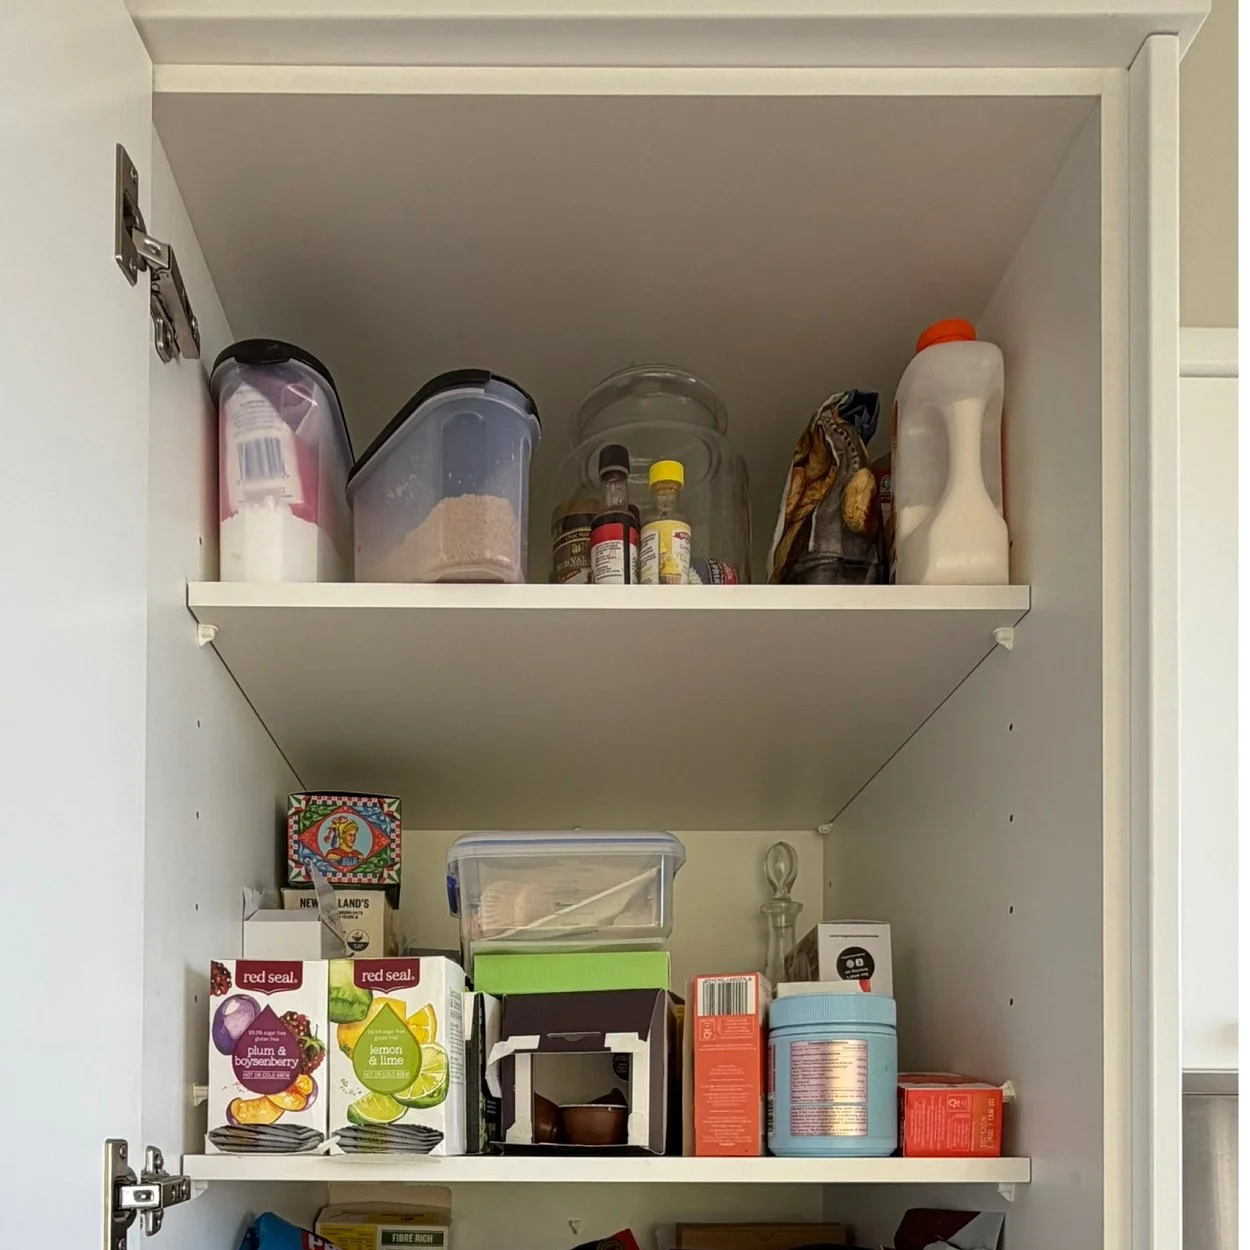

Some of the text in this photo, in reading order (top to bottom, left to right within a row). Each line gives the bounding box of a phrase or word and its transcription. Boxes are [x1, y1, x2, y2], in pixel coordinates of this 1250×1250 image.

[243, 971, 294, 983] red seal
[362, 969, 411, 982] red seal
[247, 1045, 287, 1057] plum &
[370, 1044, 403, 1055] lemon
[235, 1056, 299, 1069] boysenberry
[369, 1055, 404, 1065] & lime
[392, 1233, 433, 1243] FIBRE RICH
